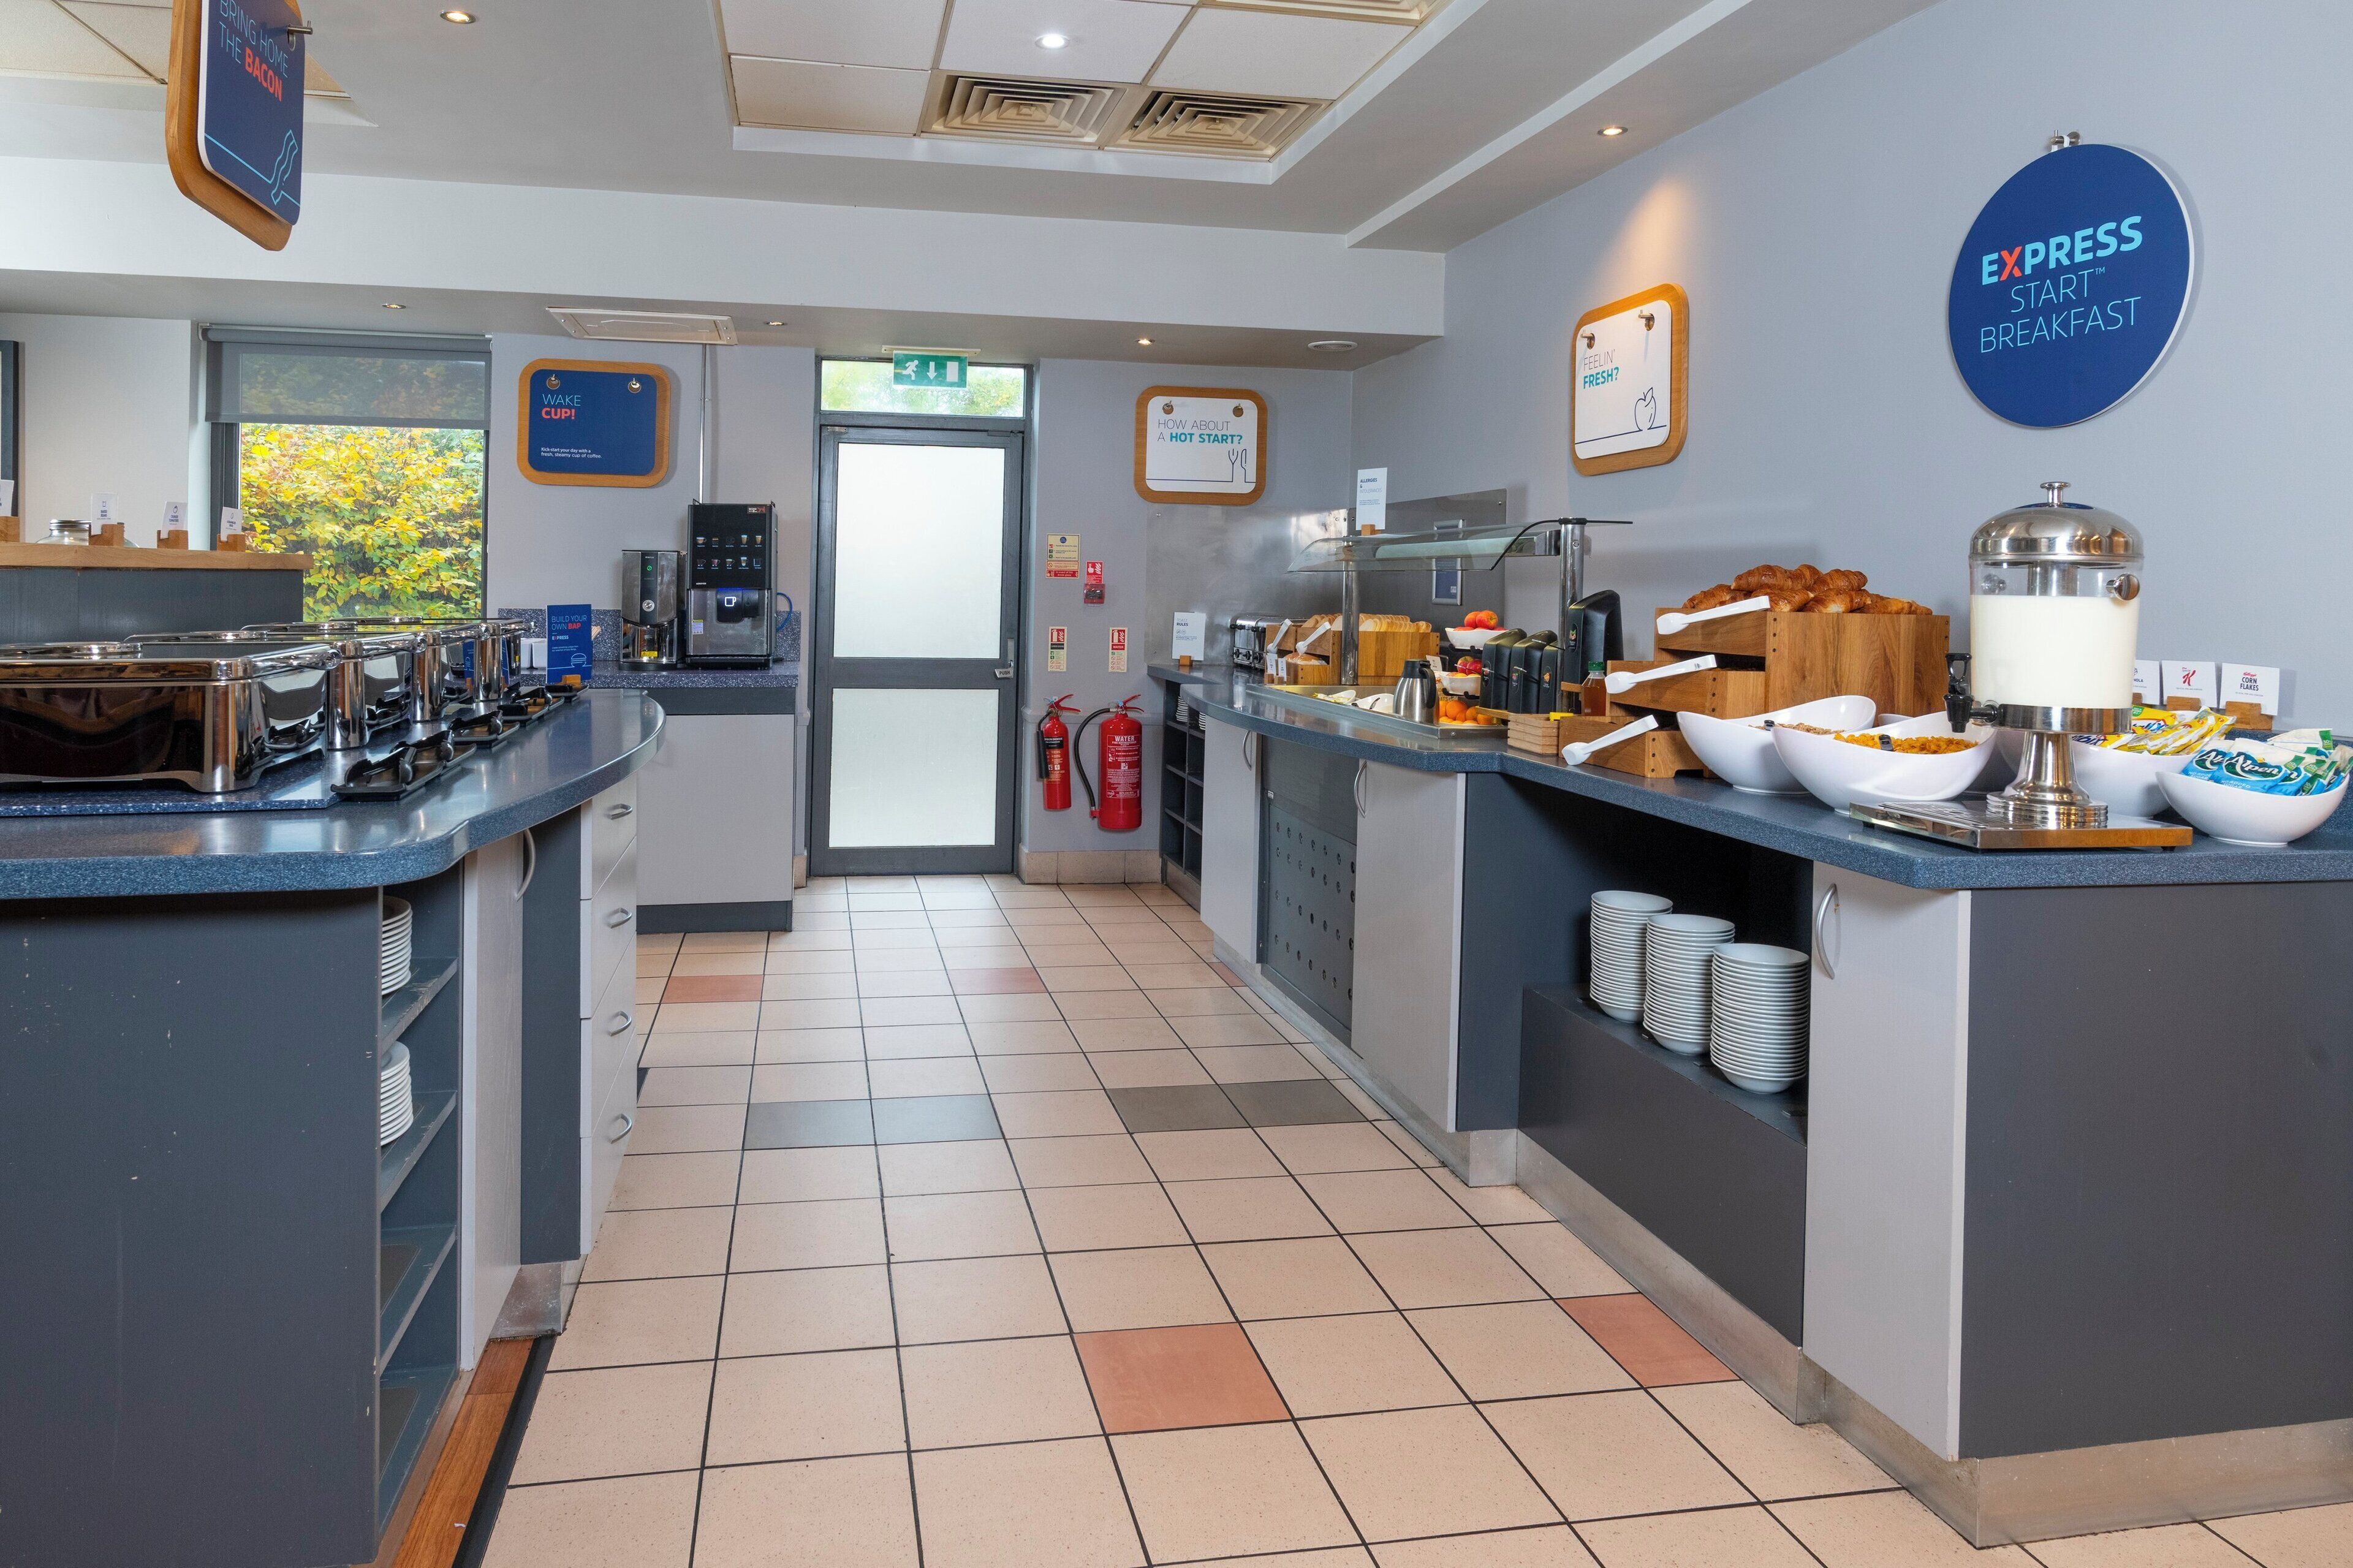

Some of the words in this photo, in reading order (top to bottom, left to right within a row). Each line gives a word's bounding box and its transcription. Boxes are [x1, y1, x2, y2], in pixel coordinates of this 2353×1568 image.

[220, 0, 256, 45] BRING
[260, 29, 288, 78] HOME
[219, 21, 241, 64] THE
[246, 47, 282, 102] BACON
[1982, 215, 2143, 286] EXPRESS
[1980, 296, 2142, 354] BREAKFAST
[1583, 366, 1620, 390] FRESH?
[542, 393, 582, 406] WAKE
[541, 407, 576, 420] CUP!
[1158, 419, 1188, 430] HOW
[1191, 420, 1231, 431] ABOUT
[1157, 431, 1165, 442] A
[1169, 432, 1195, 443] HOT
[1198, 433, 1243, 445] START?
[2182, 669, 2196, 686] K
[2225, 755, 2279, 779] Alpen
[2229, 779, 2251, 789] ADDED
